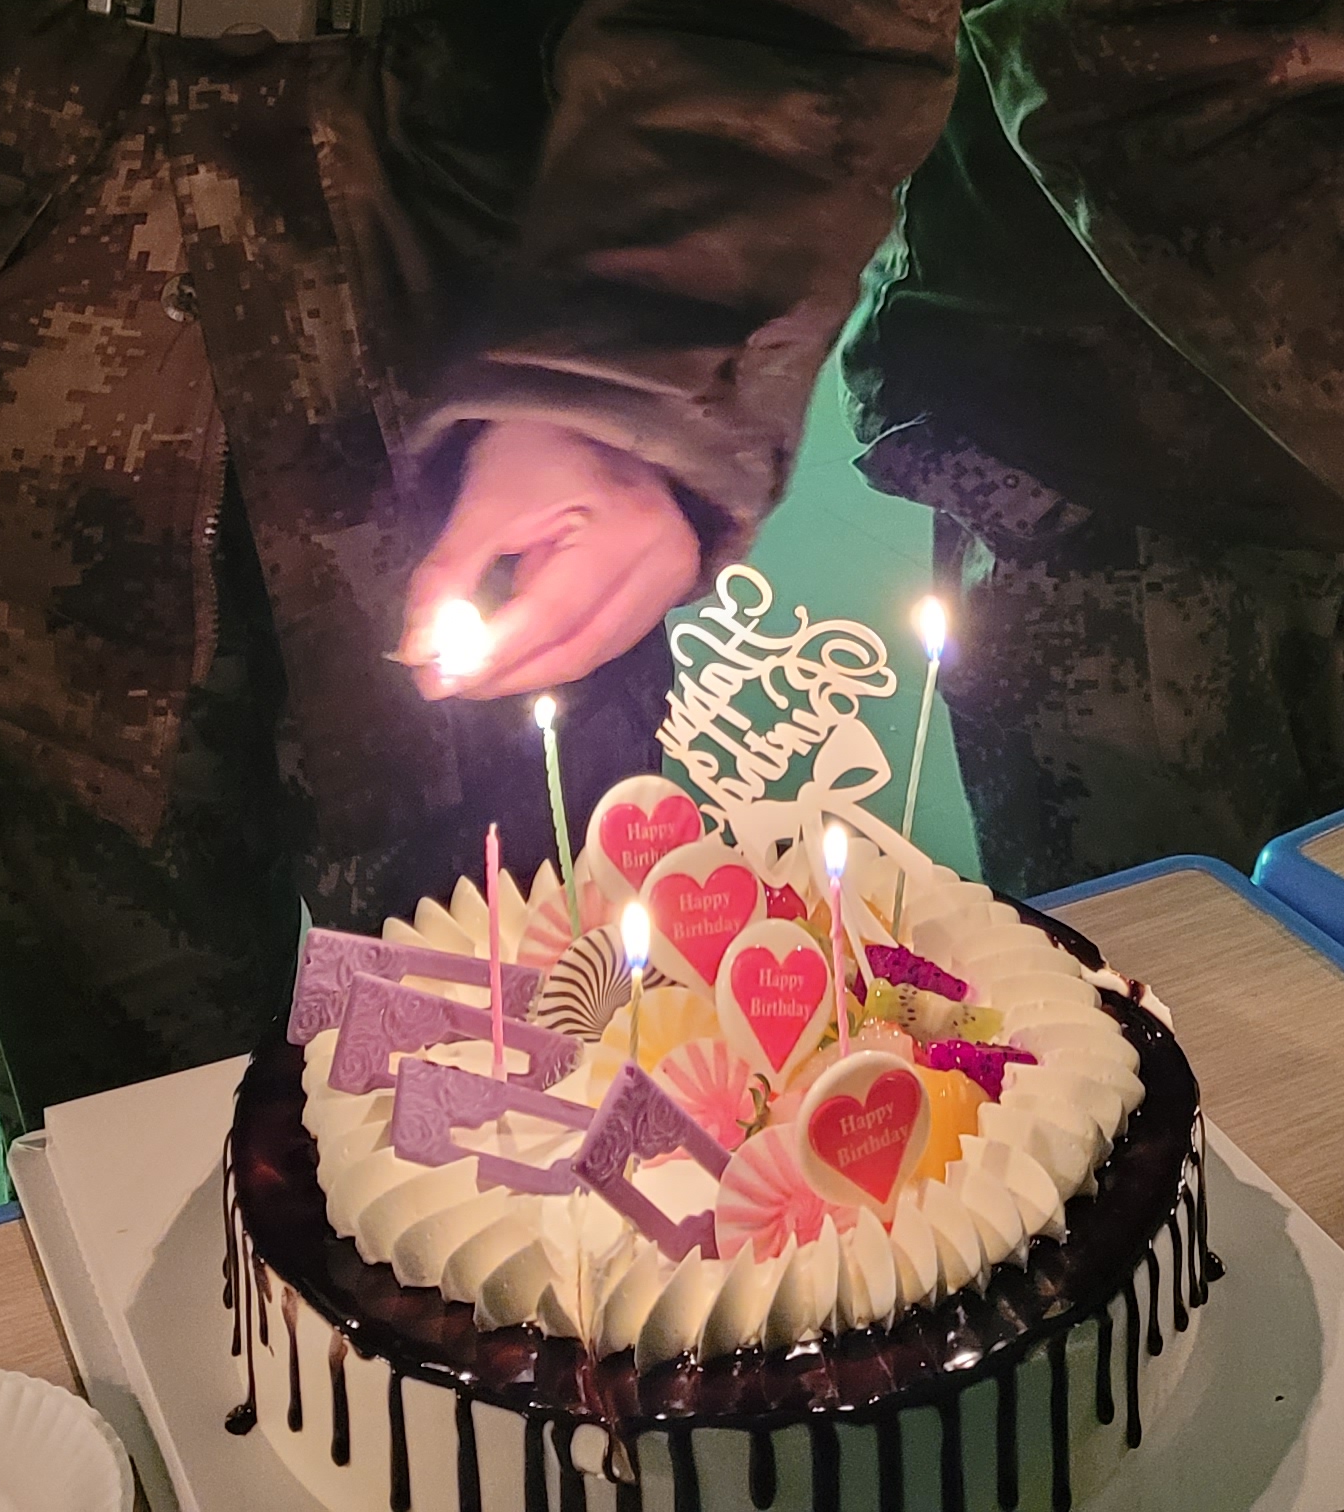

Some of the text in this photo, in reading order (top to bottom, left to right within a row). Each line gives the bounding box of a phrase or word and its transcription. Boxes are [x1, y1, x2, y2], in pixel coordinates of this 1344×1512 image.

[627, 821, 675, 842] Happy
[679, 891, 730, 912] Happy
[673, 915, 740, 939] Birthday
[759, 968, 805, 992] Happy
[751, 997, 810, 1022] Birthday
[839, 1101, 895, 1137] Happy
[837, 1124, 909, 1168] Birthday
